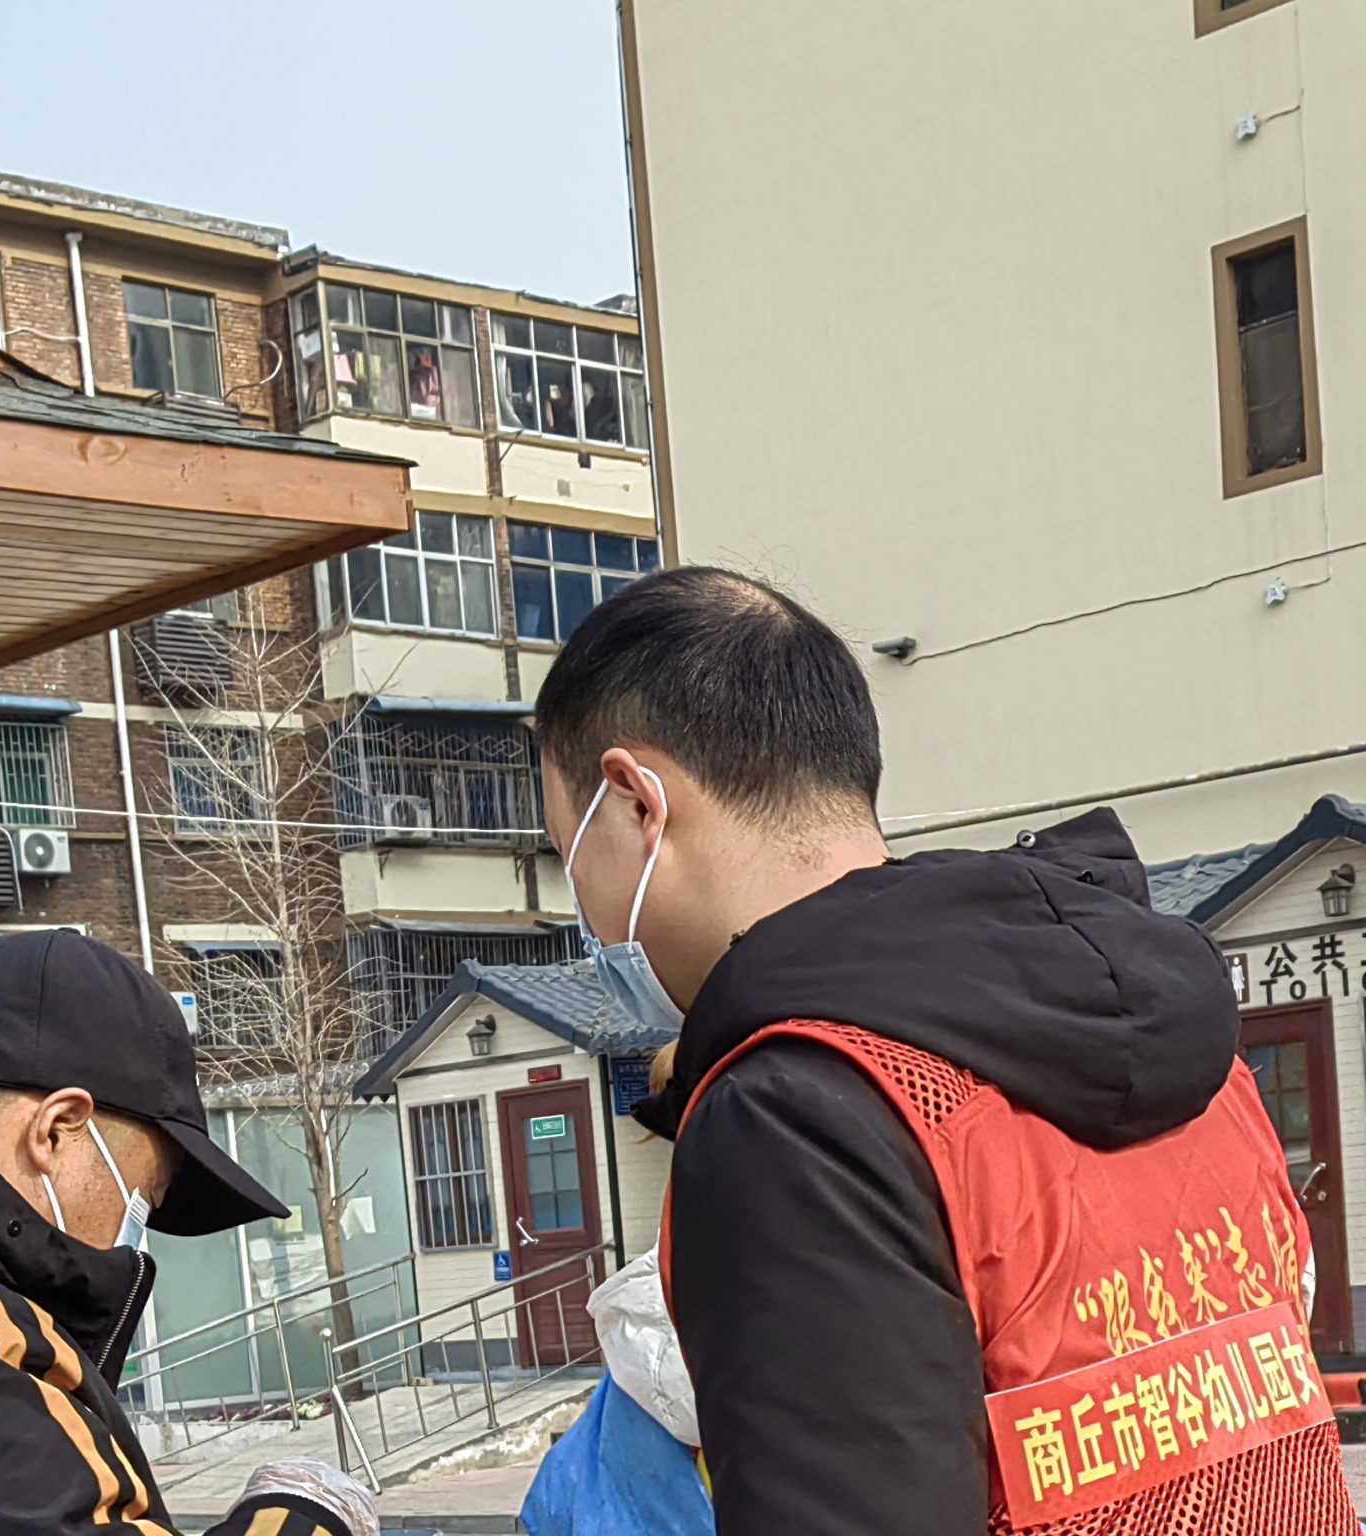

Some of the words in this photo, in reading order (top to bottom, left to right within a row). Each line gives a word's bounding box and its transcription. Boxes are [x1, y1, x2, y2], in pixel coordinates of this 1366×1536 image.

[1015, 1324, 1321, 1503] 商丘市智谷幼儿园女
